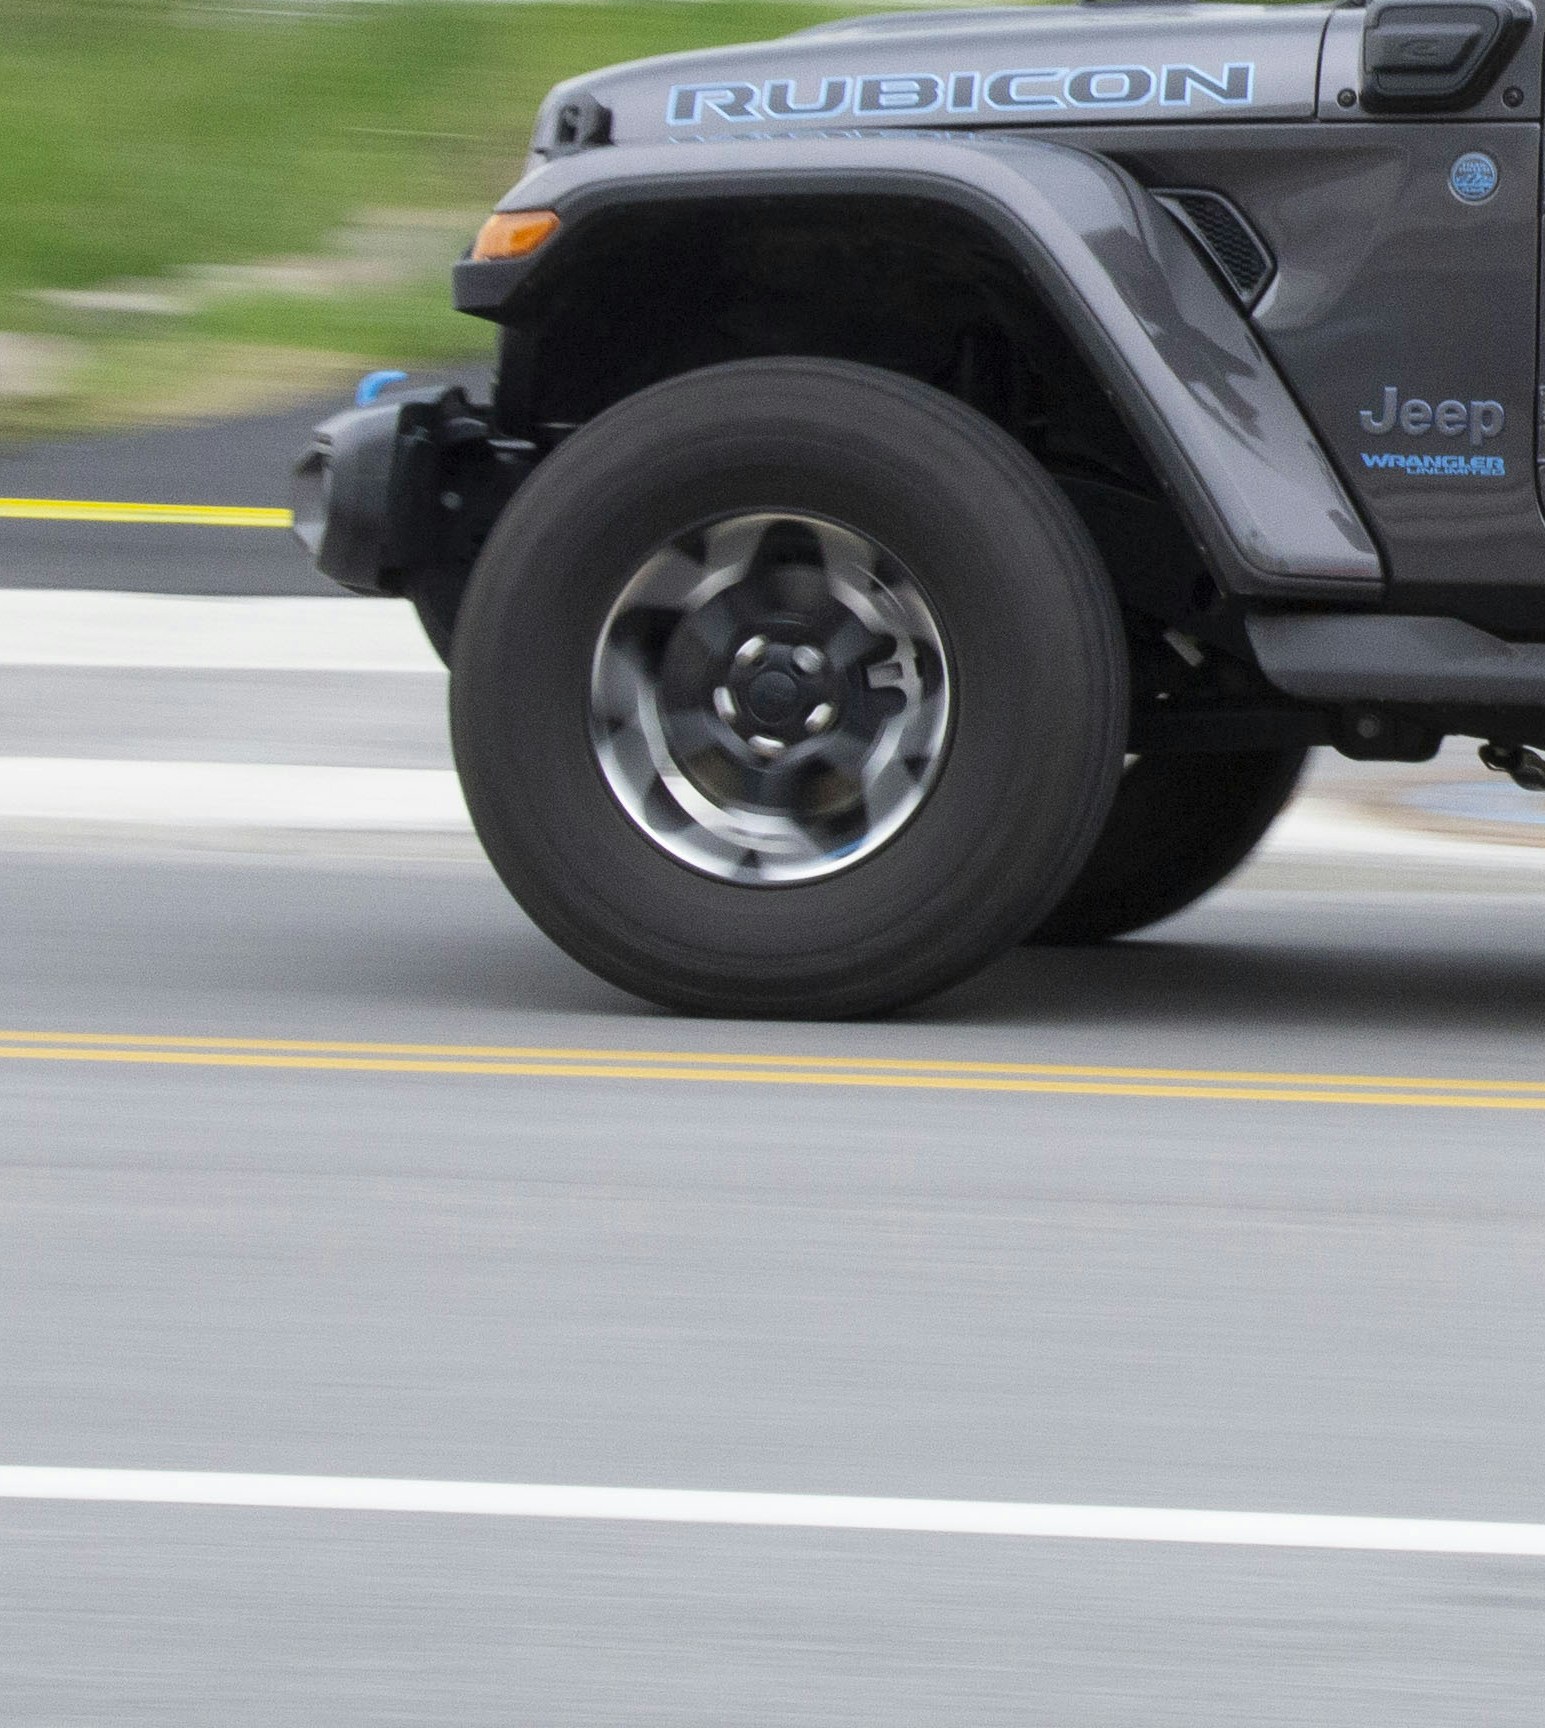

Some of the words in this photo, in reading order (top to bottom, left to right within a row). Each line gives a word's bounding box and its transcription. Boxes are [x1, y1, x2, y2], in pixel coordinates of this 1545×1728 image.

[666, 62, 1255, 126] RUBICON
[1359, 386, 1504, 446] Jeep
[1360, 453, 1504, 468] WRANGLER
